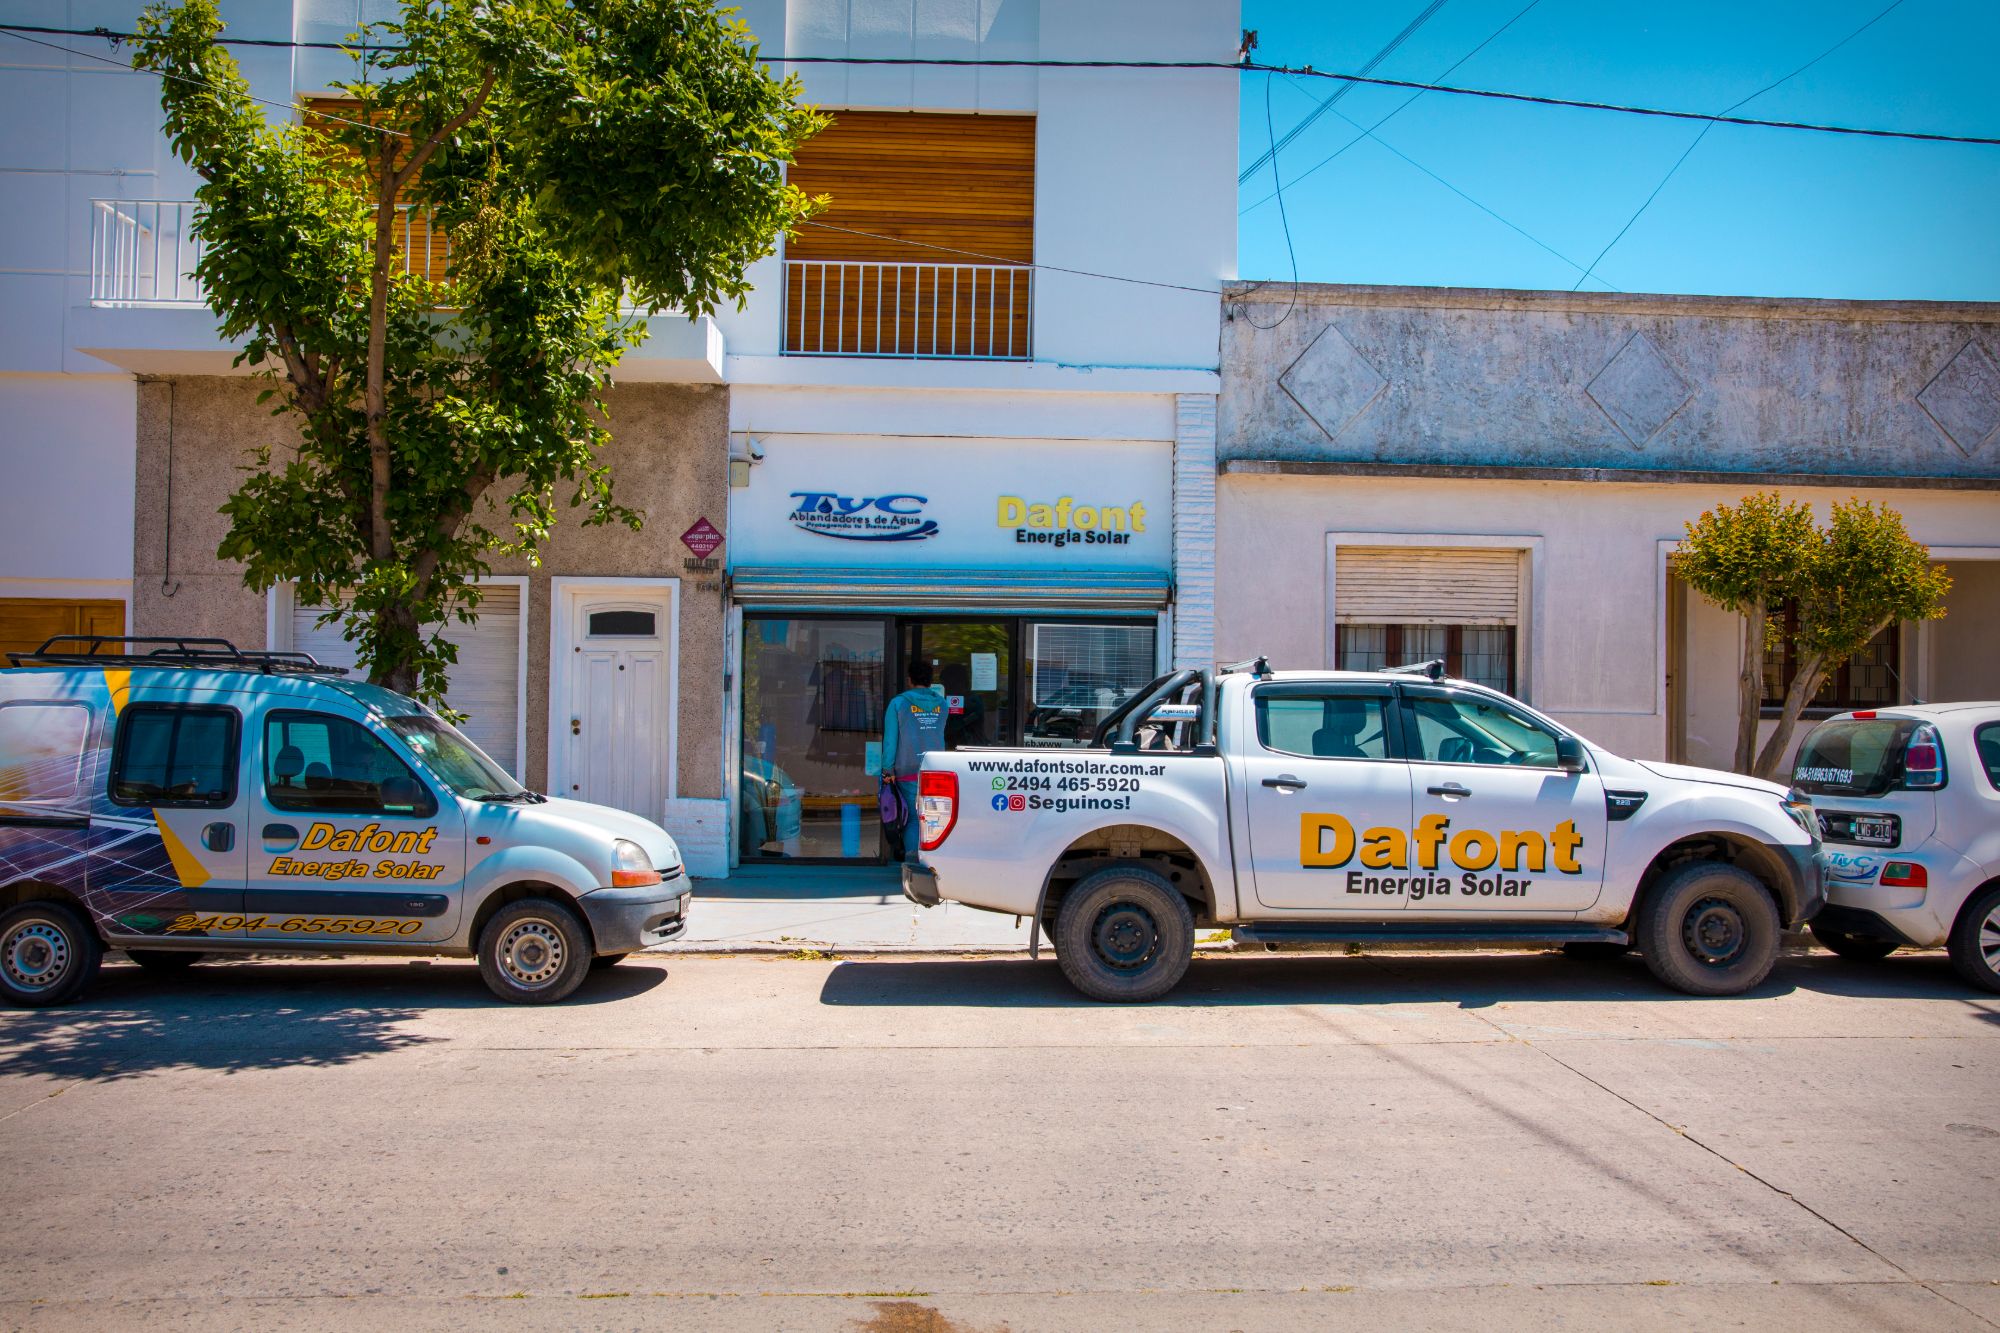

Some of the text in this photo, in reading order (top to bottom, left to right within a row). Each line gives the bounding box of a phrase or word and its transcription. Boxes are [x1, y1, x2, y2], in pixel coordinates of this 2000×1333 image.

[789, 512, 921, 526] Ablandadores de Agua
[997, 496, 1147, 532] Dafont
[1016, 529, 1130, 547] Energia Solar
[968, 758, 1166, 776] www.dafontsolar.com.ar
[1007, 775, 1140, 792] 2494 465-5920
[1028, 794, 1131, 813] Seguinos!
[299, 822, 438, 854] Dafont
[1874, 825, 1891, 839] 214
[1300, 812, 1583, 874] Dafont
[268, 856, 445, 880] Energia Solar
[1346, 871, 1532, 900] Energia Solar
[165, 914, 424, 935] 2494-655920
